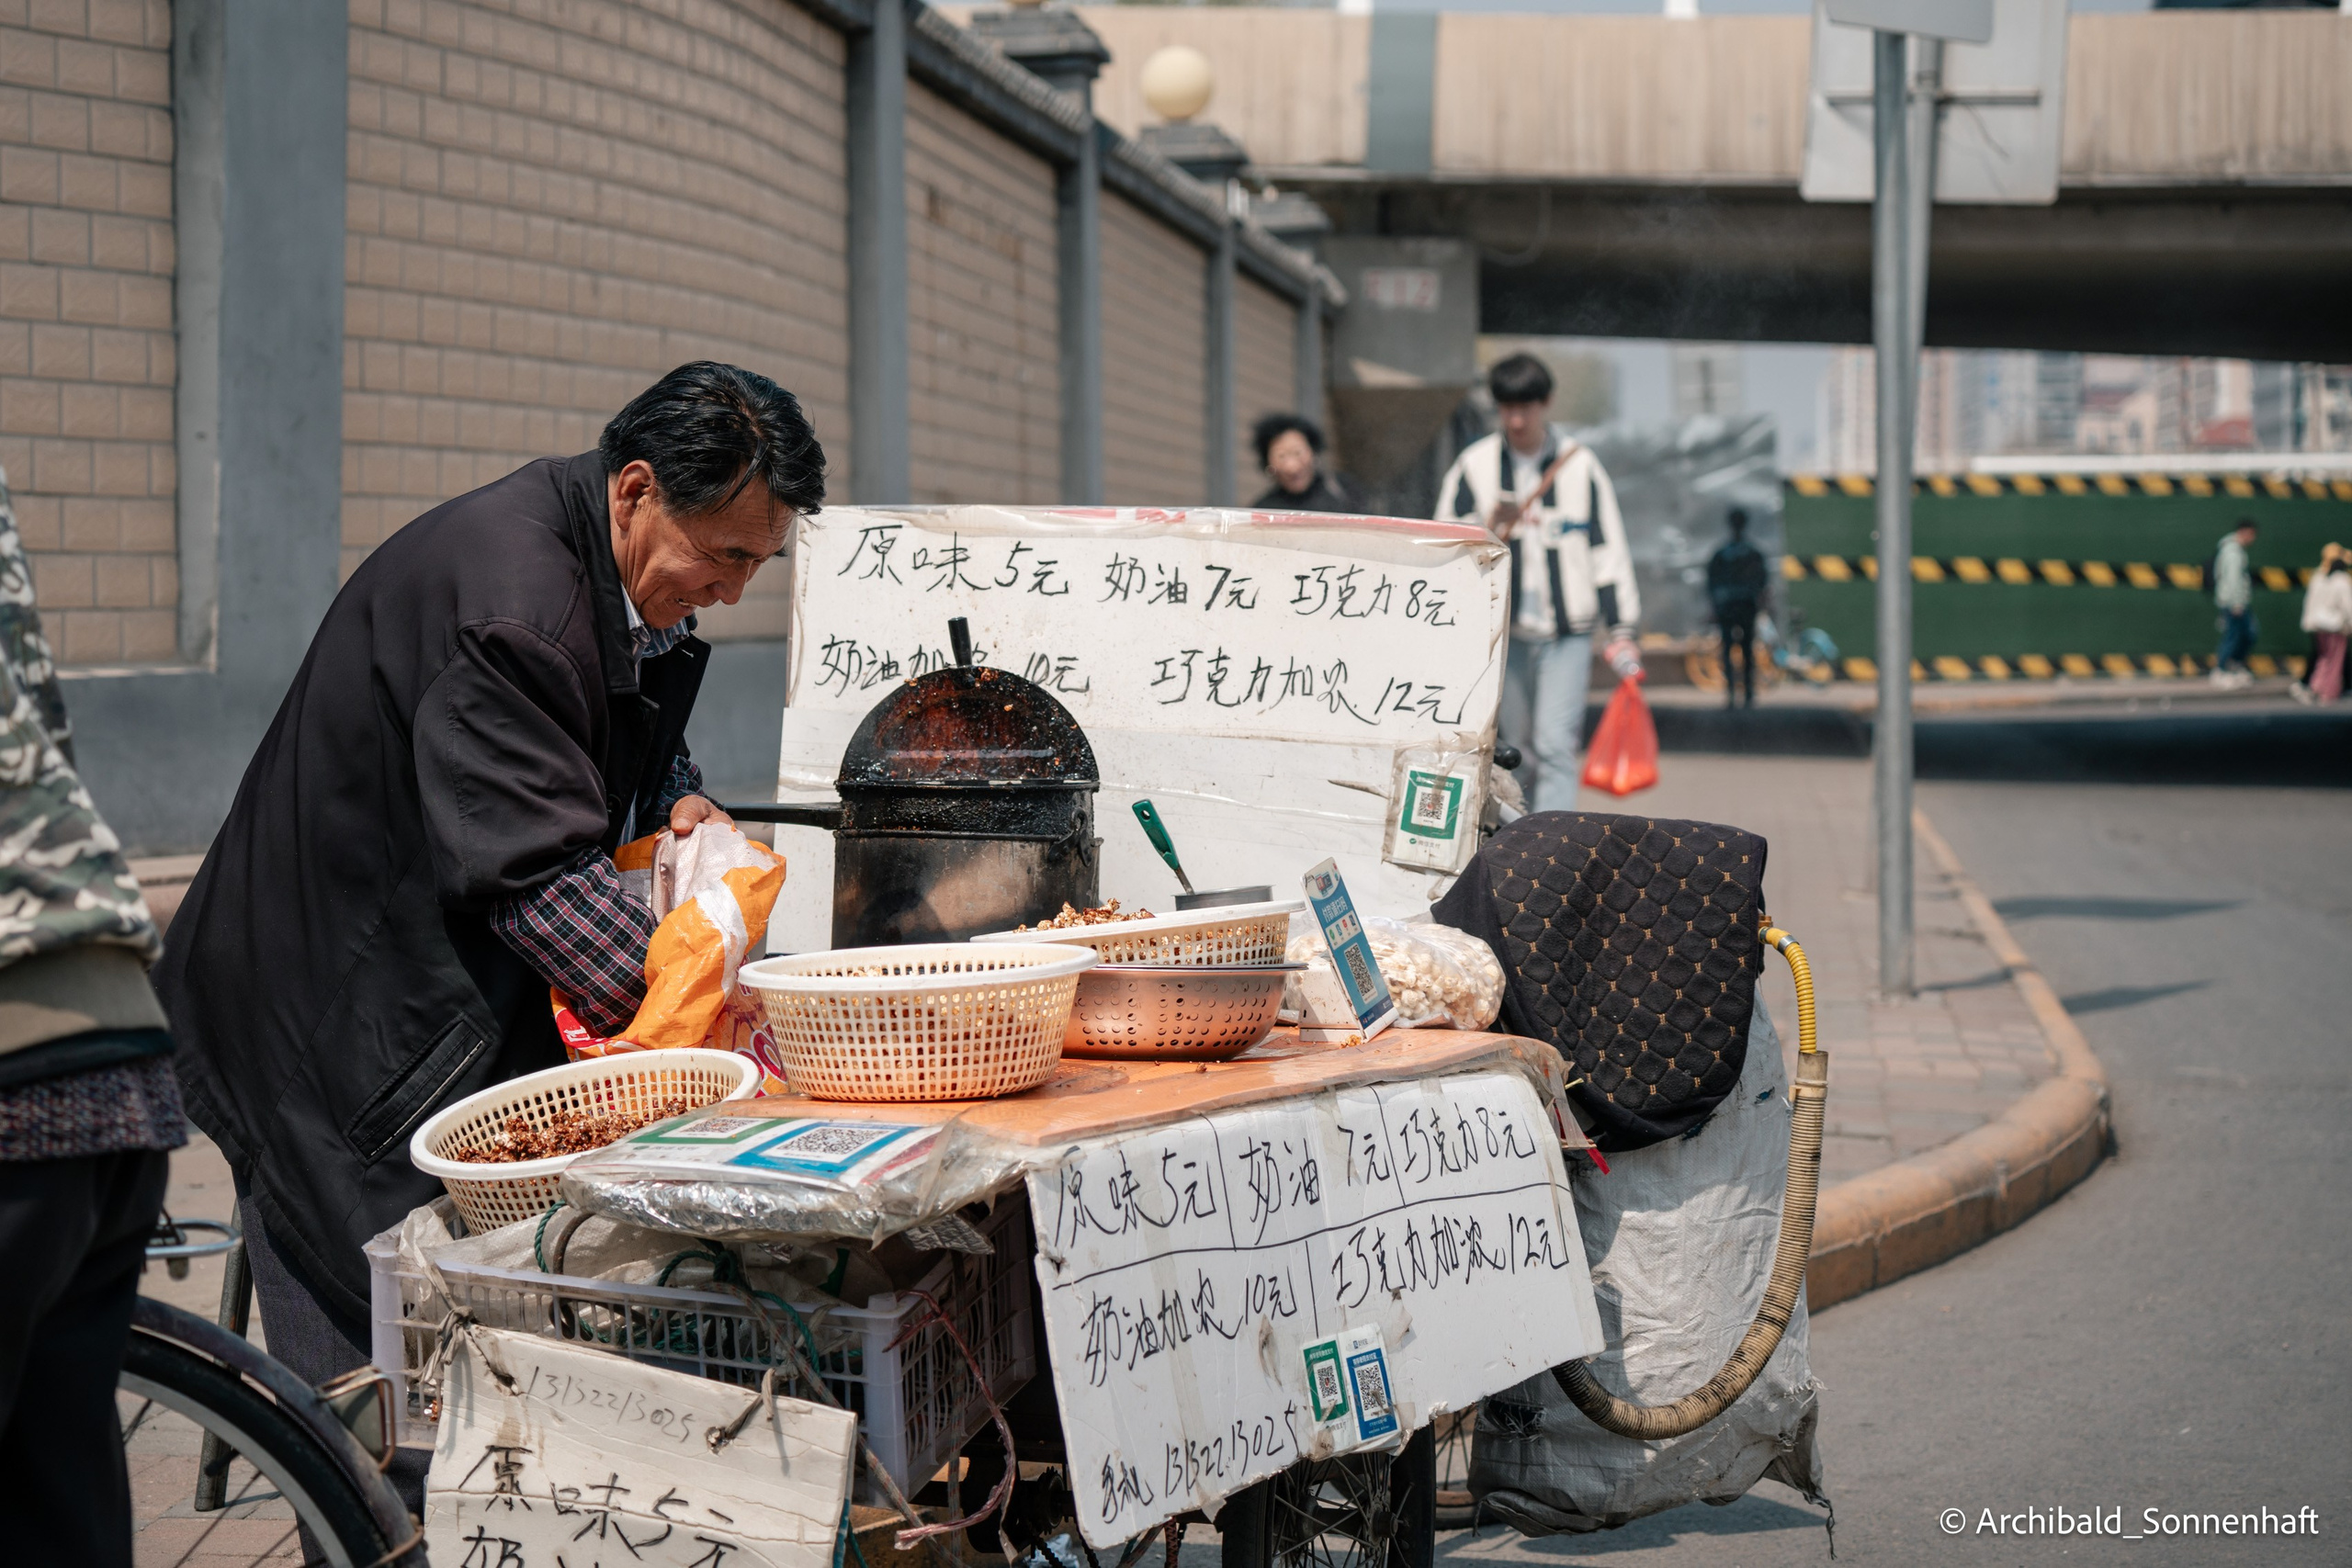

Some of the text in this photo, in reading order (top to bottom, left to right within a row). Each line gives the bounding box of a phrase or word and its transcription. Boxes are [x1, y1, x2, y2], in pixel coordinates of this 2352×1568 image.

[837, 525, 1456, 626] 原味5元 奶油7元 巧克力8元
[1054, 1146, 1216, 1248] 原味5元
[1399, 1102, 1536, 1183] 巧克力8元
[526, 1366, 695, 1443] 13132213025
[1165, 1399, 1300, 1498] 13132213025
